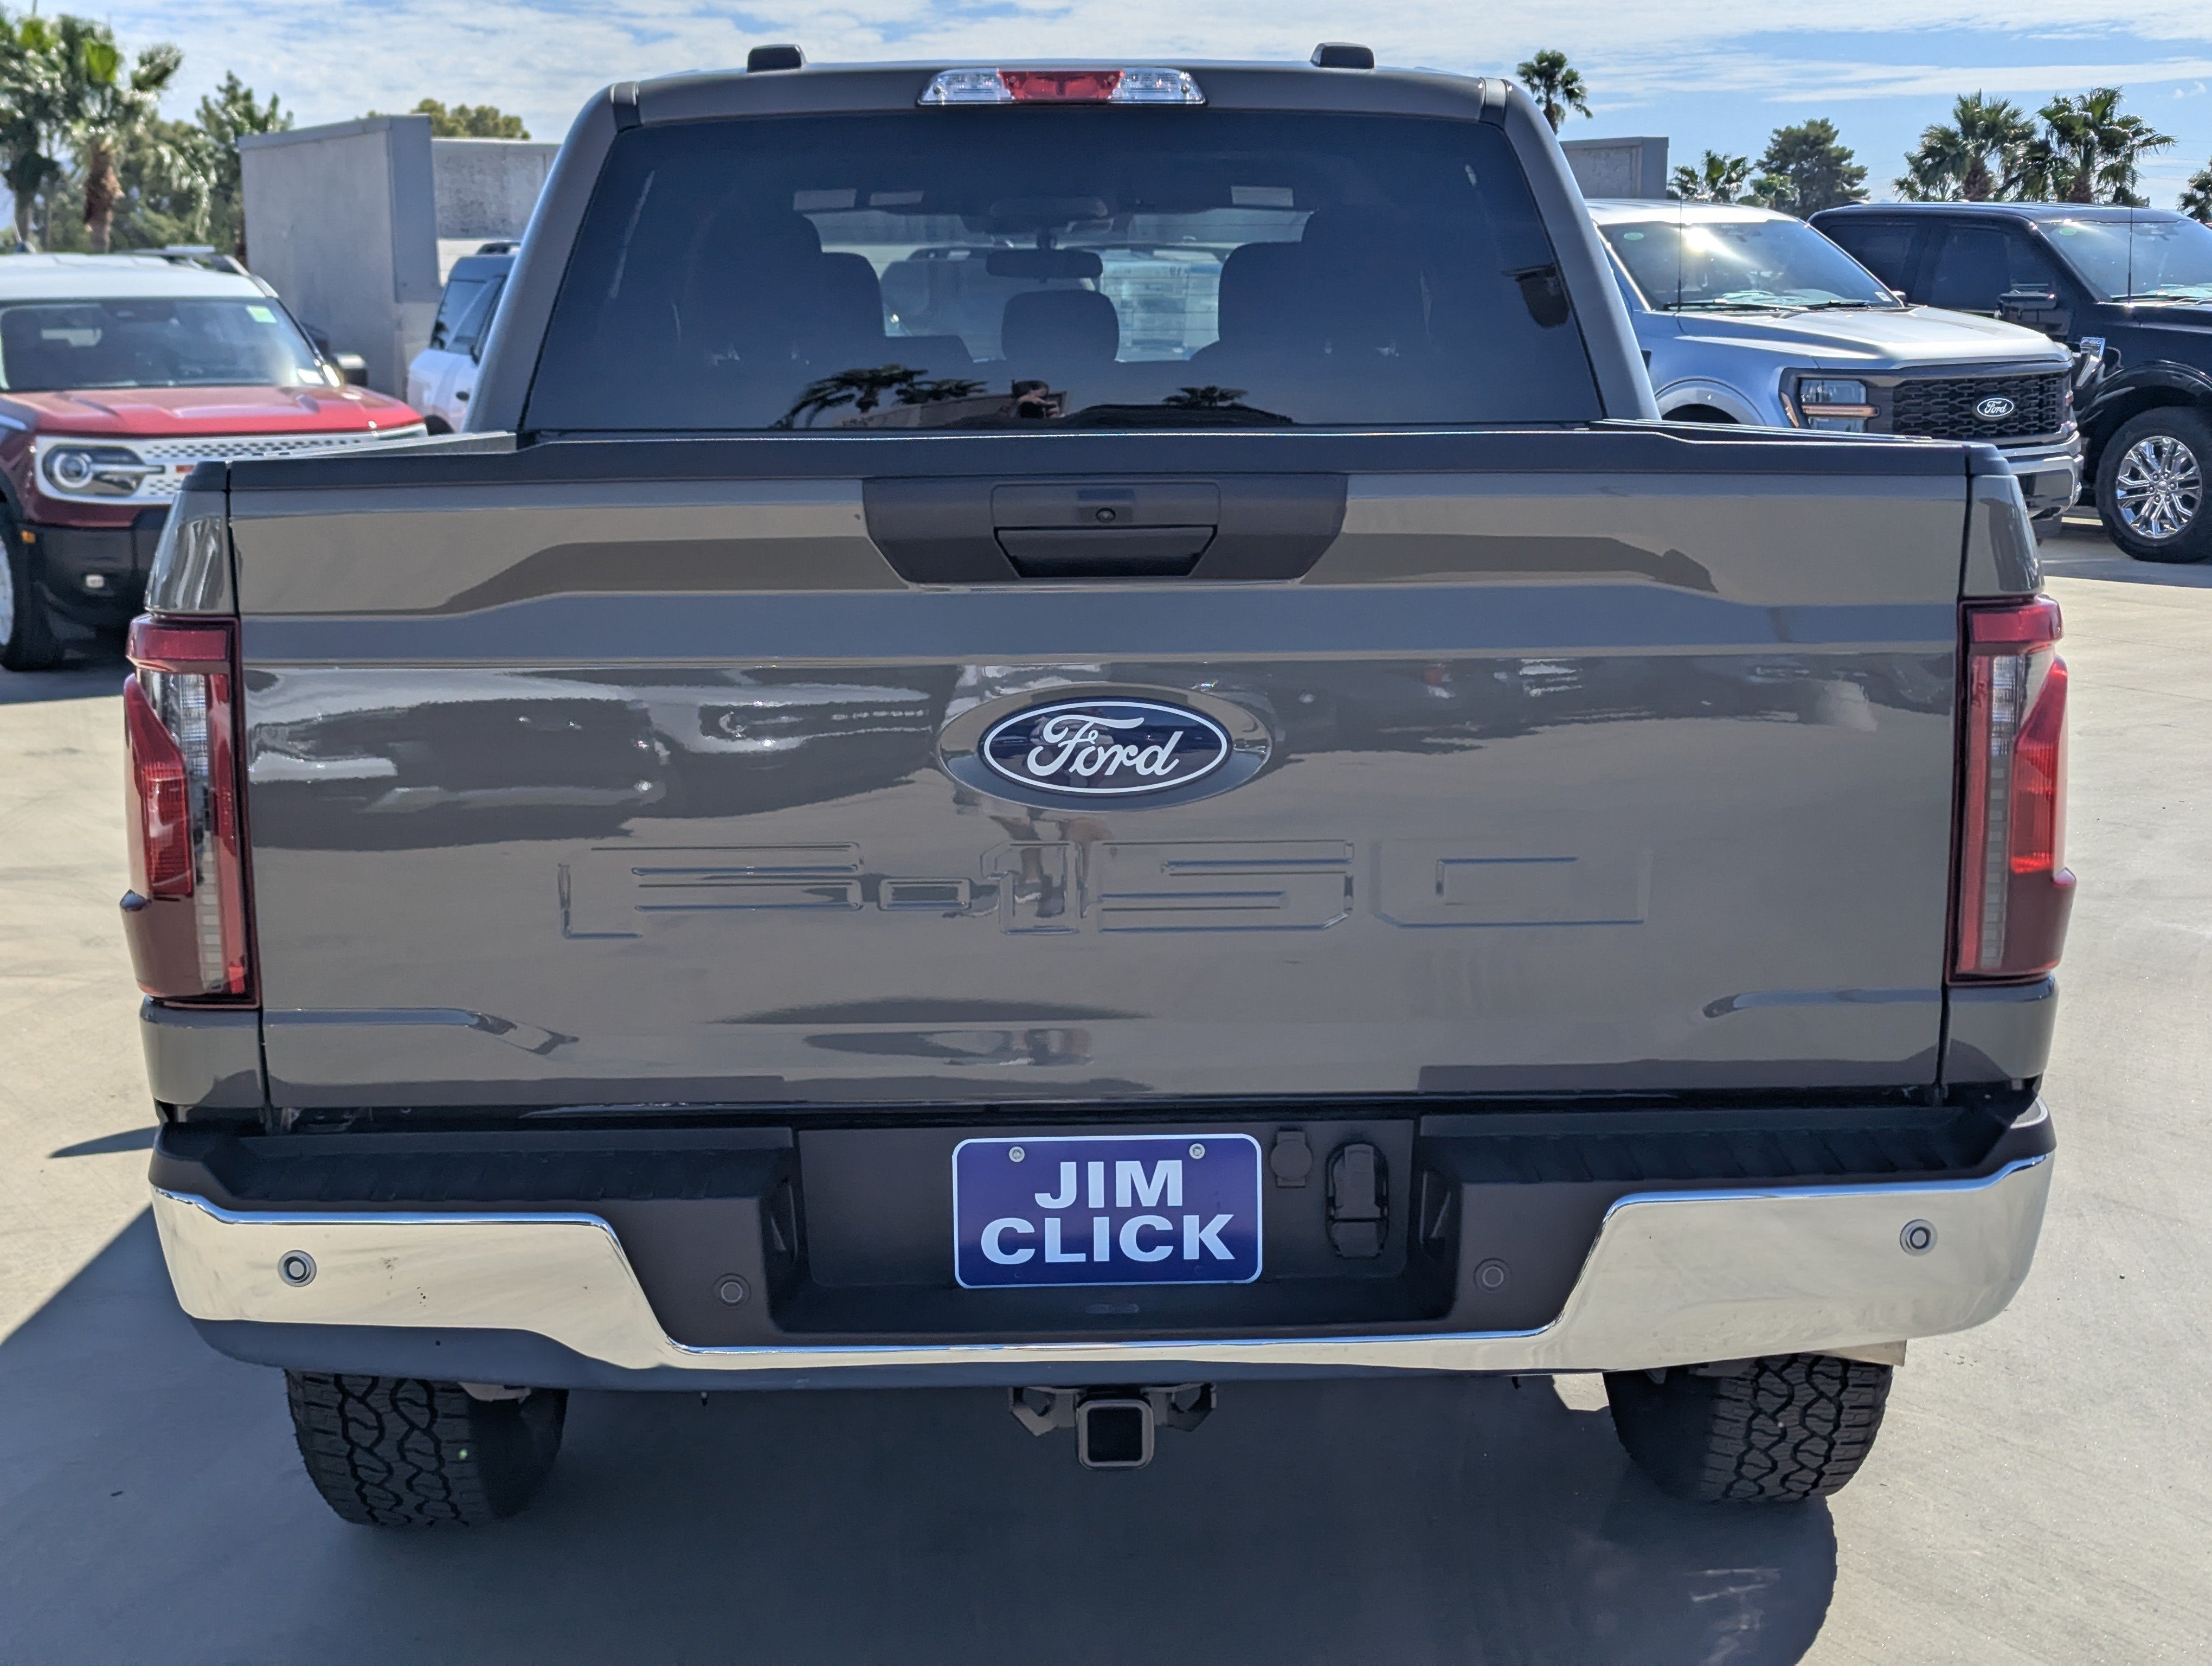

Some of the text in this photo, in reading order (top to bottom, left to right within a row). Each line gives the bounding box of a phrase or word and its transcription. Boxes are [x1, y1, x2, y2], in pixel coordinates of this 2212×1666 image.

[1984, 401, 2007, 413] Ford
[1028, 715, 1183, 776] Ford
[558, 841, 1649, 937] F-150
[1034, 1160, 1183, 1209] JIM
[981, 1214, 1235, 1264] CLICK
